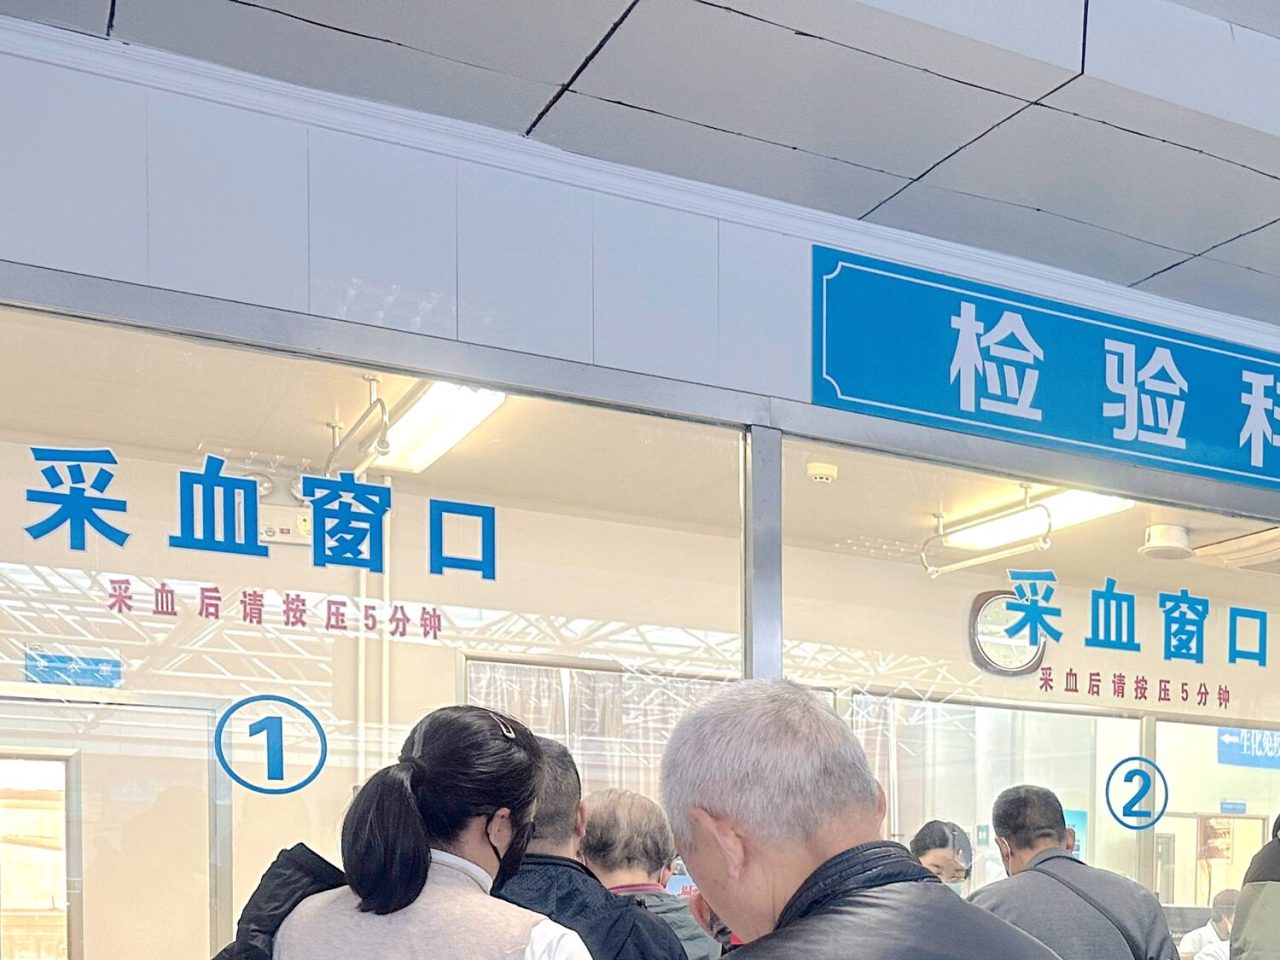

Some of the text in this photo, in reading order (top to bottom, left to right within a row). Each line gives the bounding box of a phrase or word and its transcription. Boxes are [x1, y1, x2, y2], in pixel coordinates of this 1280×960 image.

[23, 446, 497, 581] 采血窗口
[107, 577, 444, 642] 采血后请按压5分钟
[1004, 568, 1269, 668] 采血窗口
[1038, 664, 1232, 711] 采血后请按压5分钟
